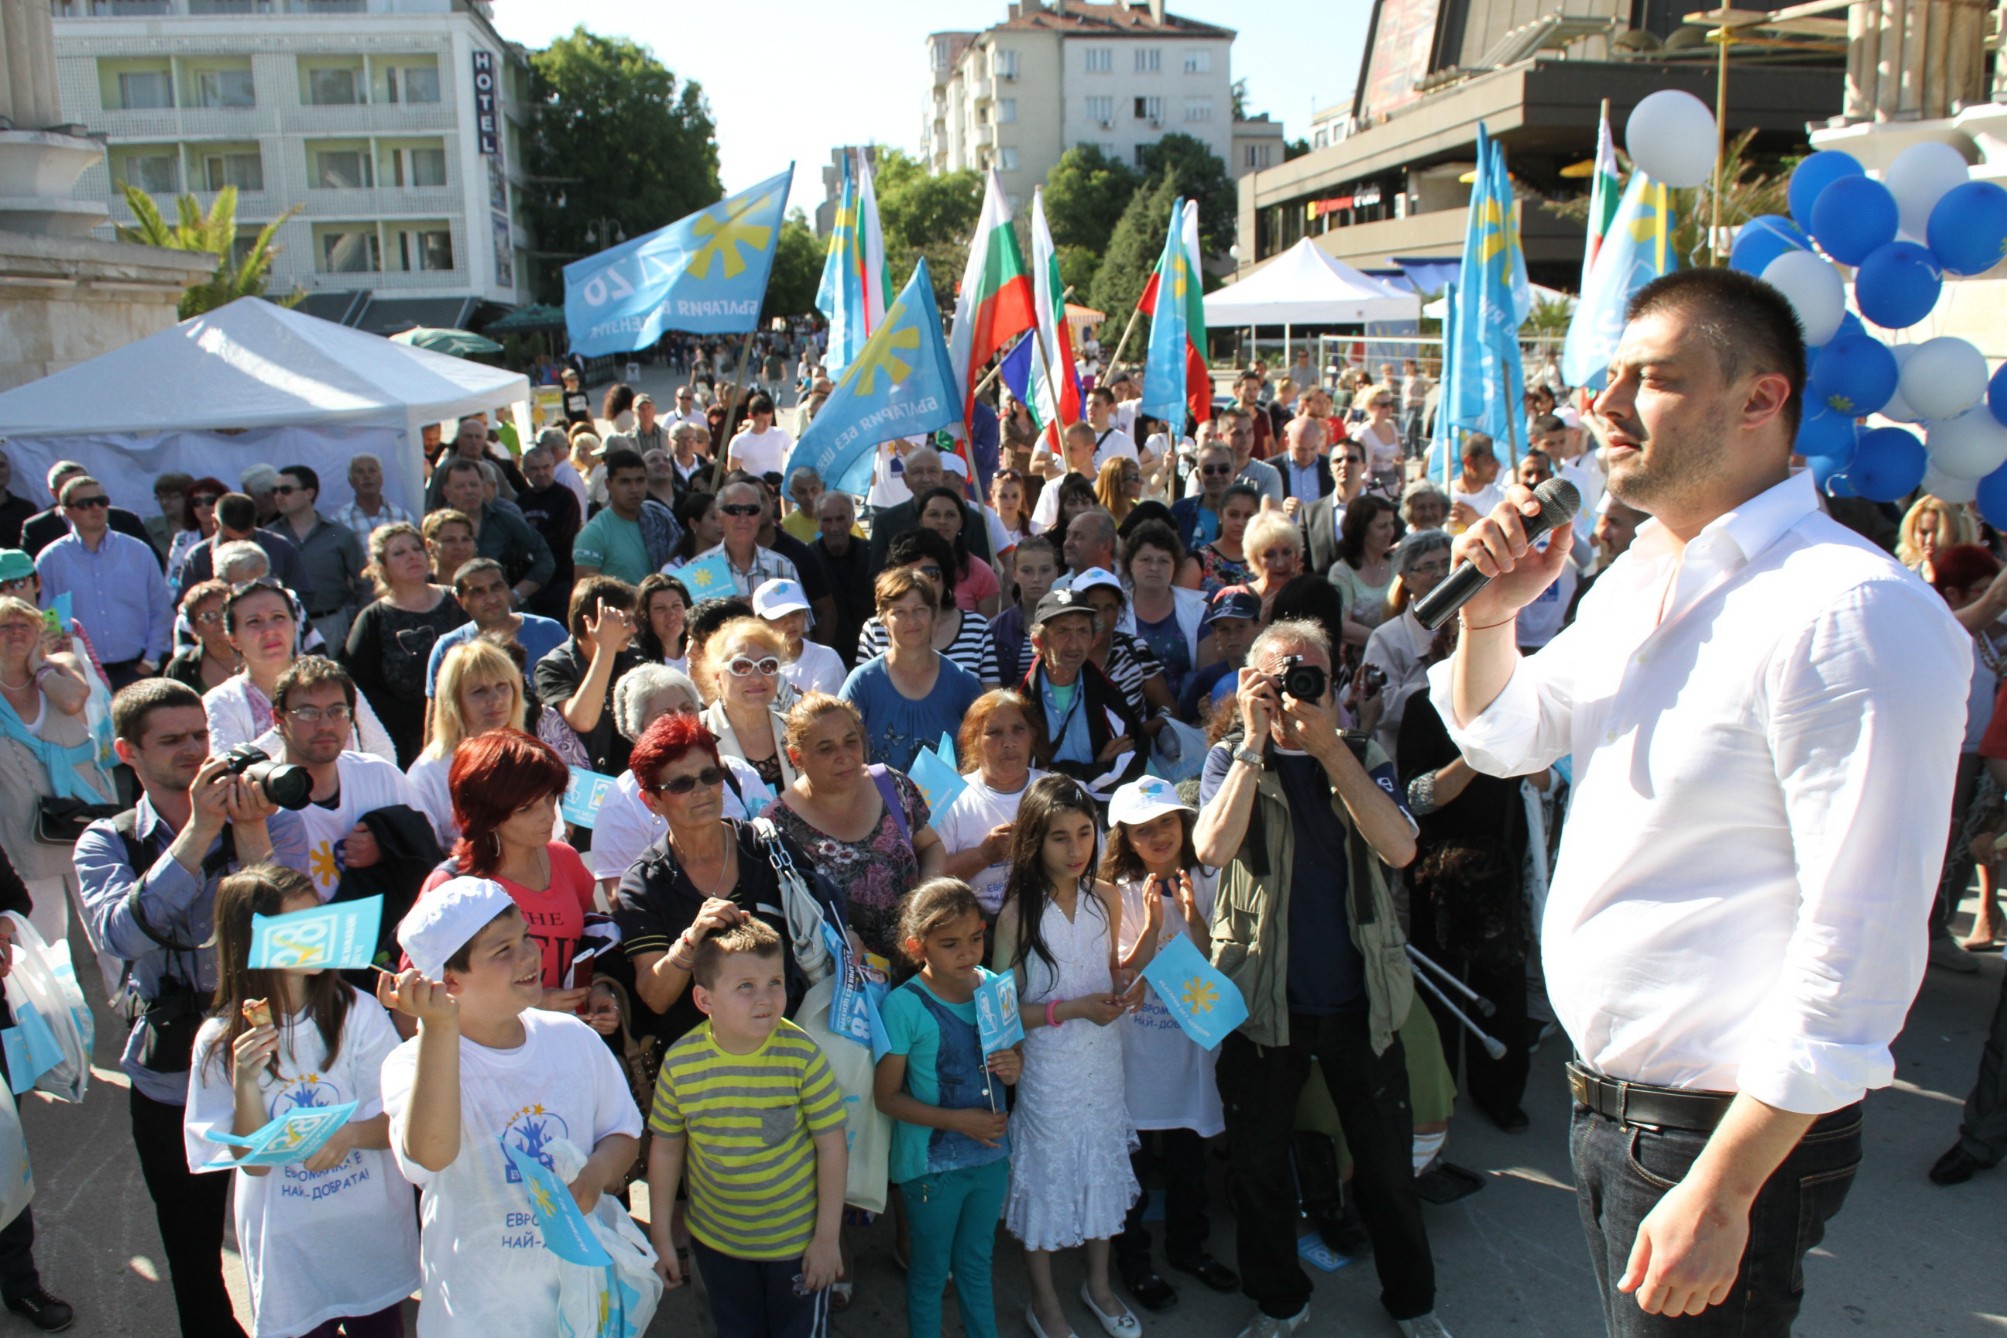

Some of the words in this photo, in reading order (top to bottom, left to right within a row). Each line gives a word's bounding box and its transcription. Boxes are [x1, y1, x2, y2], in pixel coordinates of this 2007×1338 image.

[475, 52, 495, 153] HOTEL
[521, 910, 565, 927] HE
[354, 1151, 363, 1165] Е
[281, 1167, 371, 1201] НАЙ-ДОБРАТА!
[502, 1231, 547, 1249] НАЙ-
